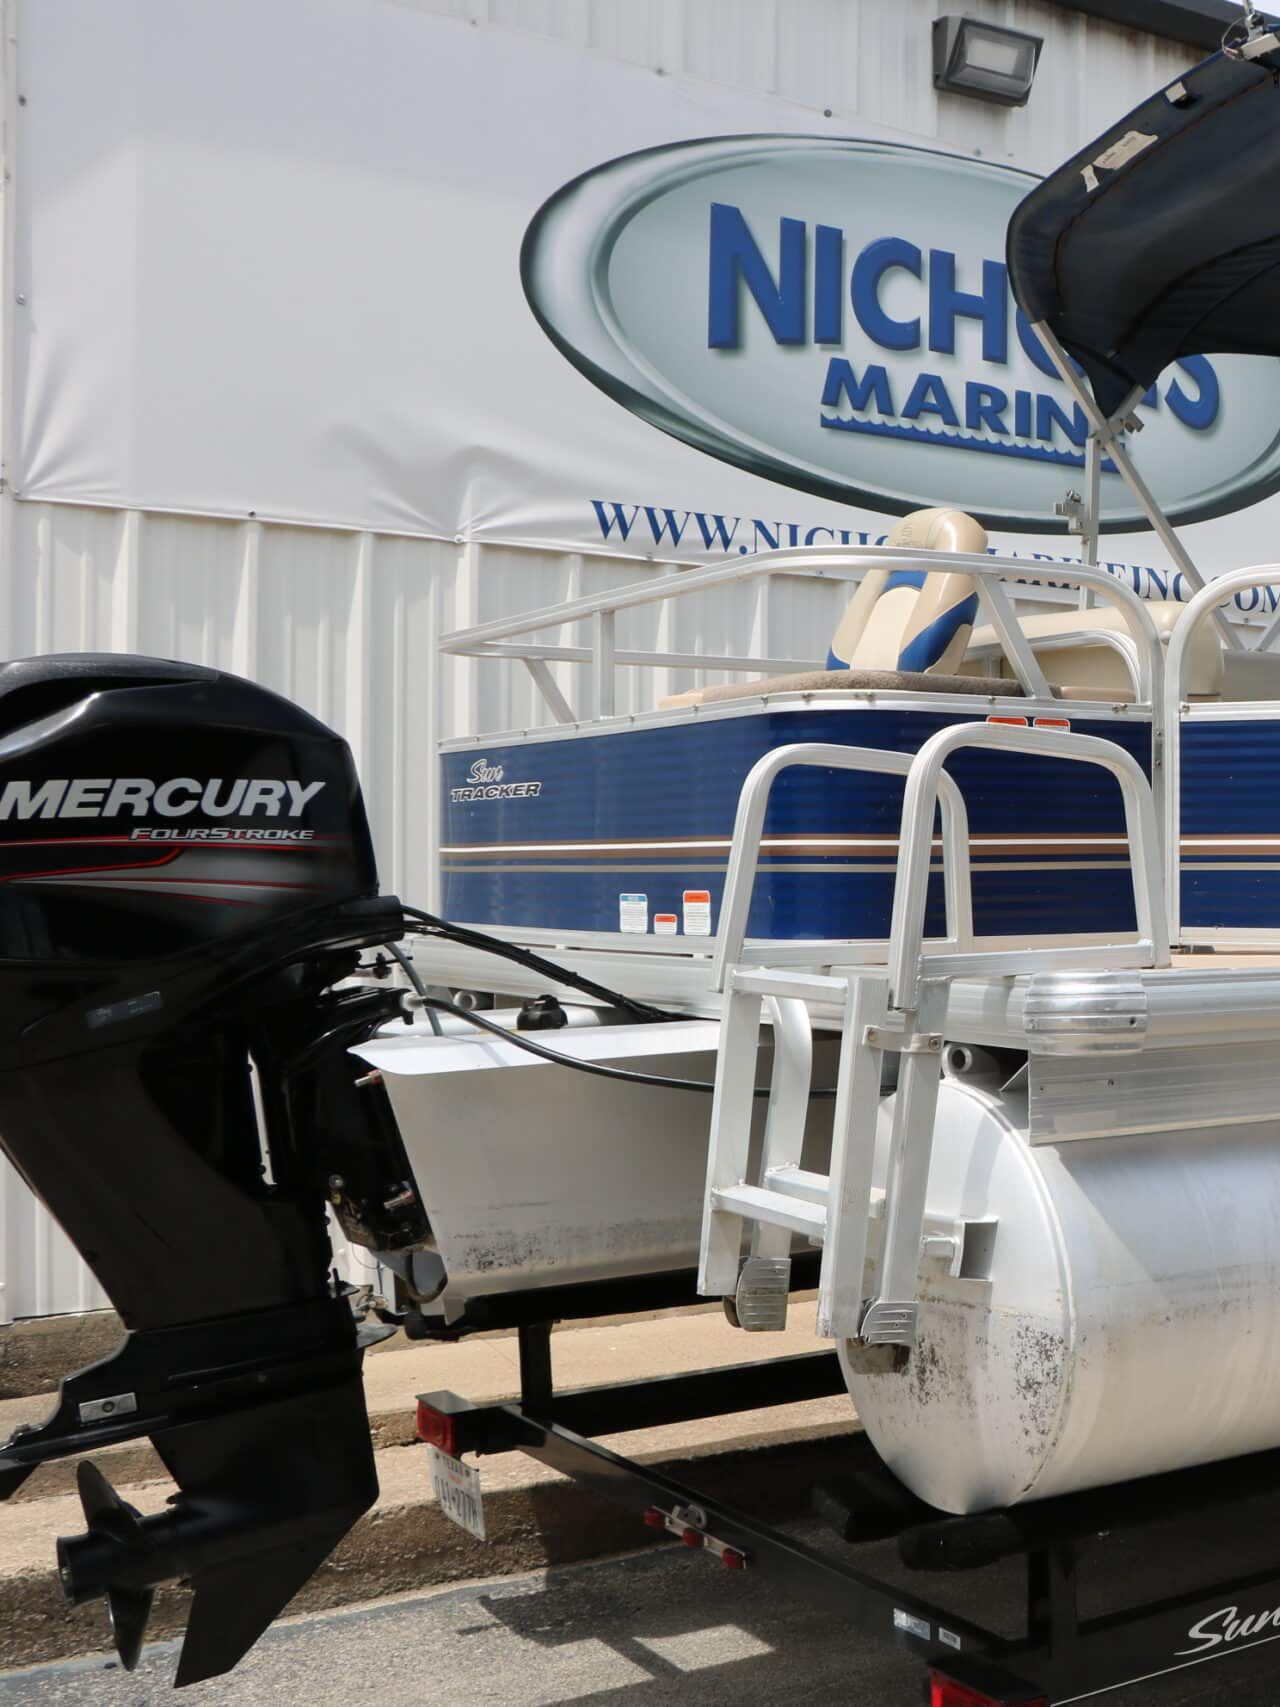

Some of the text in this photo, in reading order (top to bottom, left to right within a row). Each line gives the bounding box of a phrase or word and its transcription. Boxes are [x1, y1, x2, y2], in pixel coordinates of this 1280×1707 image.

[708, 202, 1220, 431] NICHS
[821, 357, 1125, 451] MARIN
[450, 781, 542, 803] TRACKER
[466, 758, 504, 784] Sun
[0, 778, 326, 820] MERCURY
